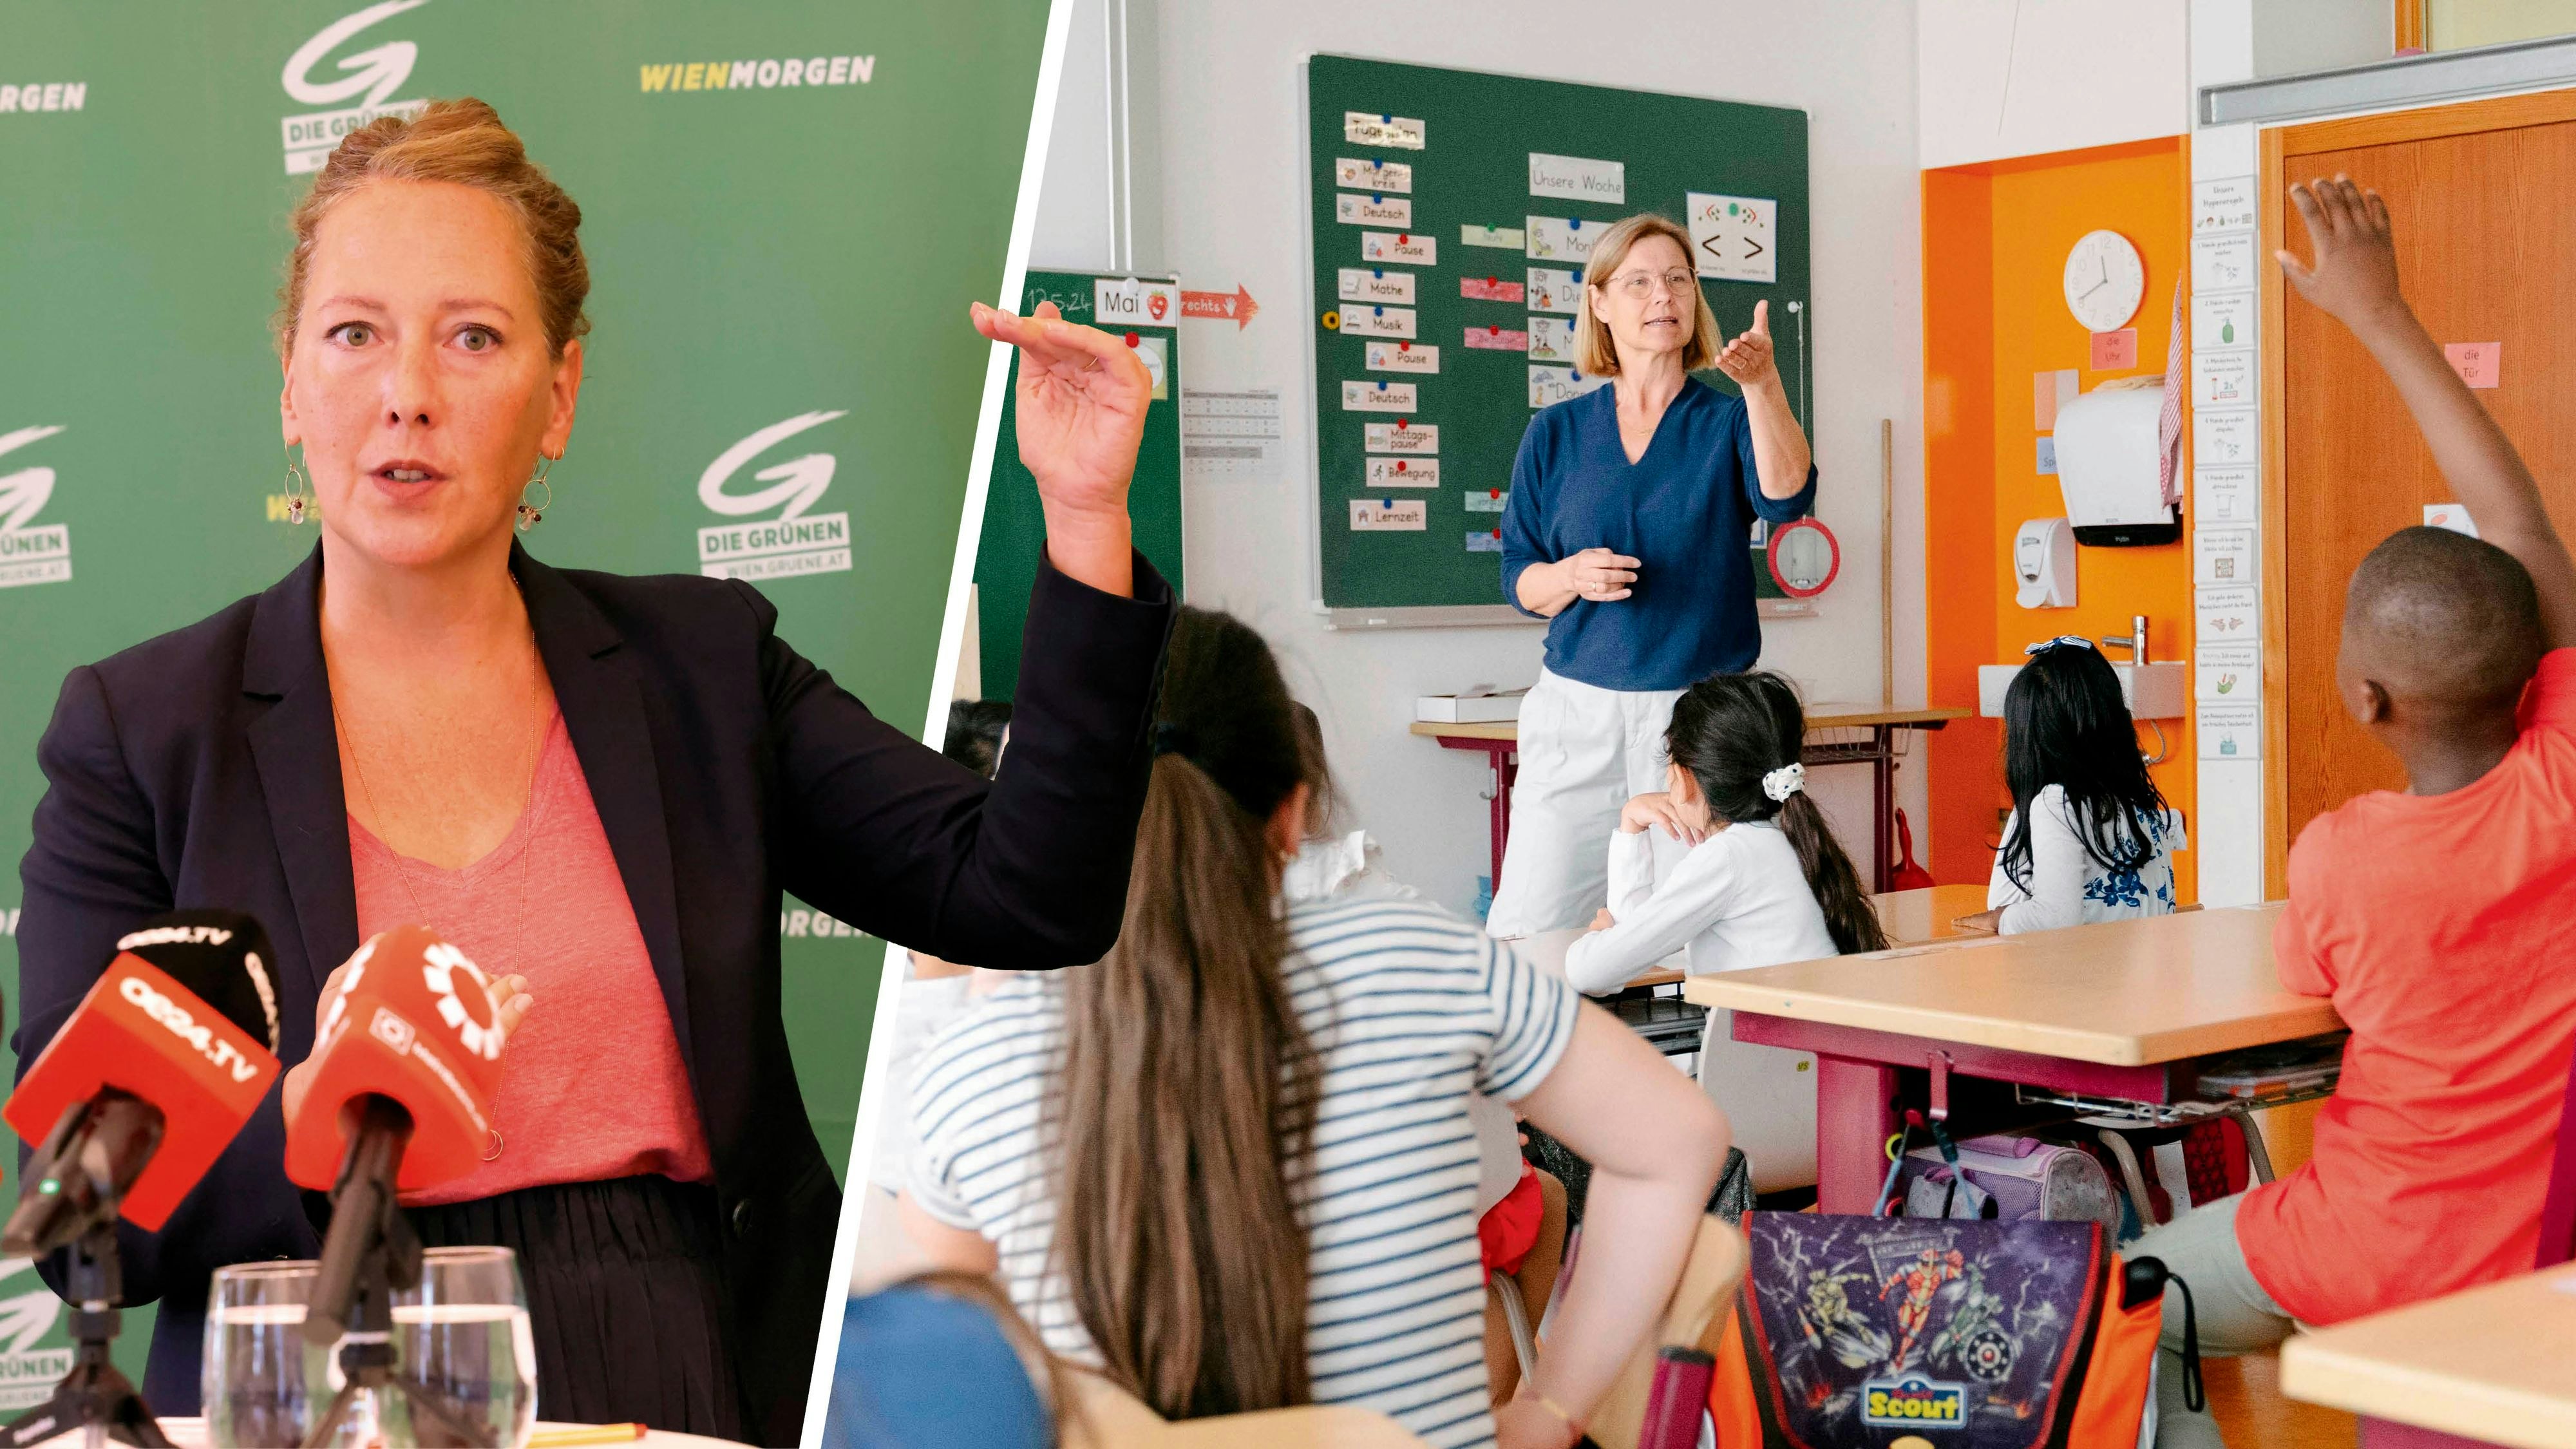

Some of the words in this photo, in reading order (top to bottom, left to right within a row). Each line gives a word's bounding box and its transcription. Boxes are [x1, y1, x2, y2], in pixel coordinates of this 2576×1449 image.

[640, 55, 875, 93] WIENMORGEN
[290, 120, 324, 142] DIE
[1532, 169, 1575, 189] Unsere
[1582, 175, 1622, 194] Woche
[1363, 205, 1405, 220] Deutsch
[1394, 243, 1425, 256] Pause
[1370, 282, 1404, 296] Mathe
[1104, 292, 1139, 314] Mai
[1373, 318, 1403, 331] Musik
[1397, 352, 1428, 365] Pause
[2464, 349, 2480, 361] die
[2463, 367, 2480, 379] Tür
[1368, 391, 1410, 404] Deutsch
[1390, 440, 1418, 451] pause
[1388, 466, 1435, 482] Bewegung
[1376, 511, 1420, 523] Lernzeit
[705, 532, 743, 554] DIE
[748, 520, 843, 549] GRÜNEN
[1869, 1390, 1958, 1419] Scout
